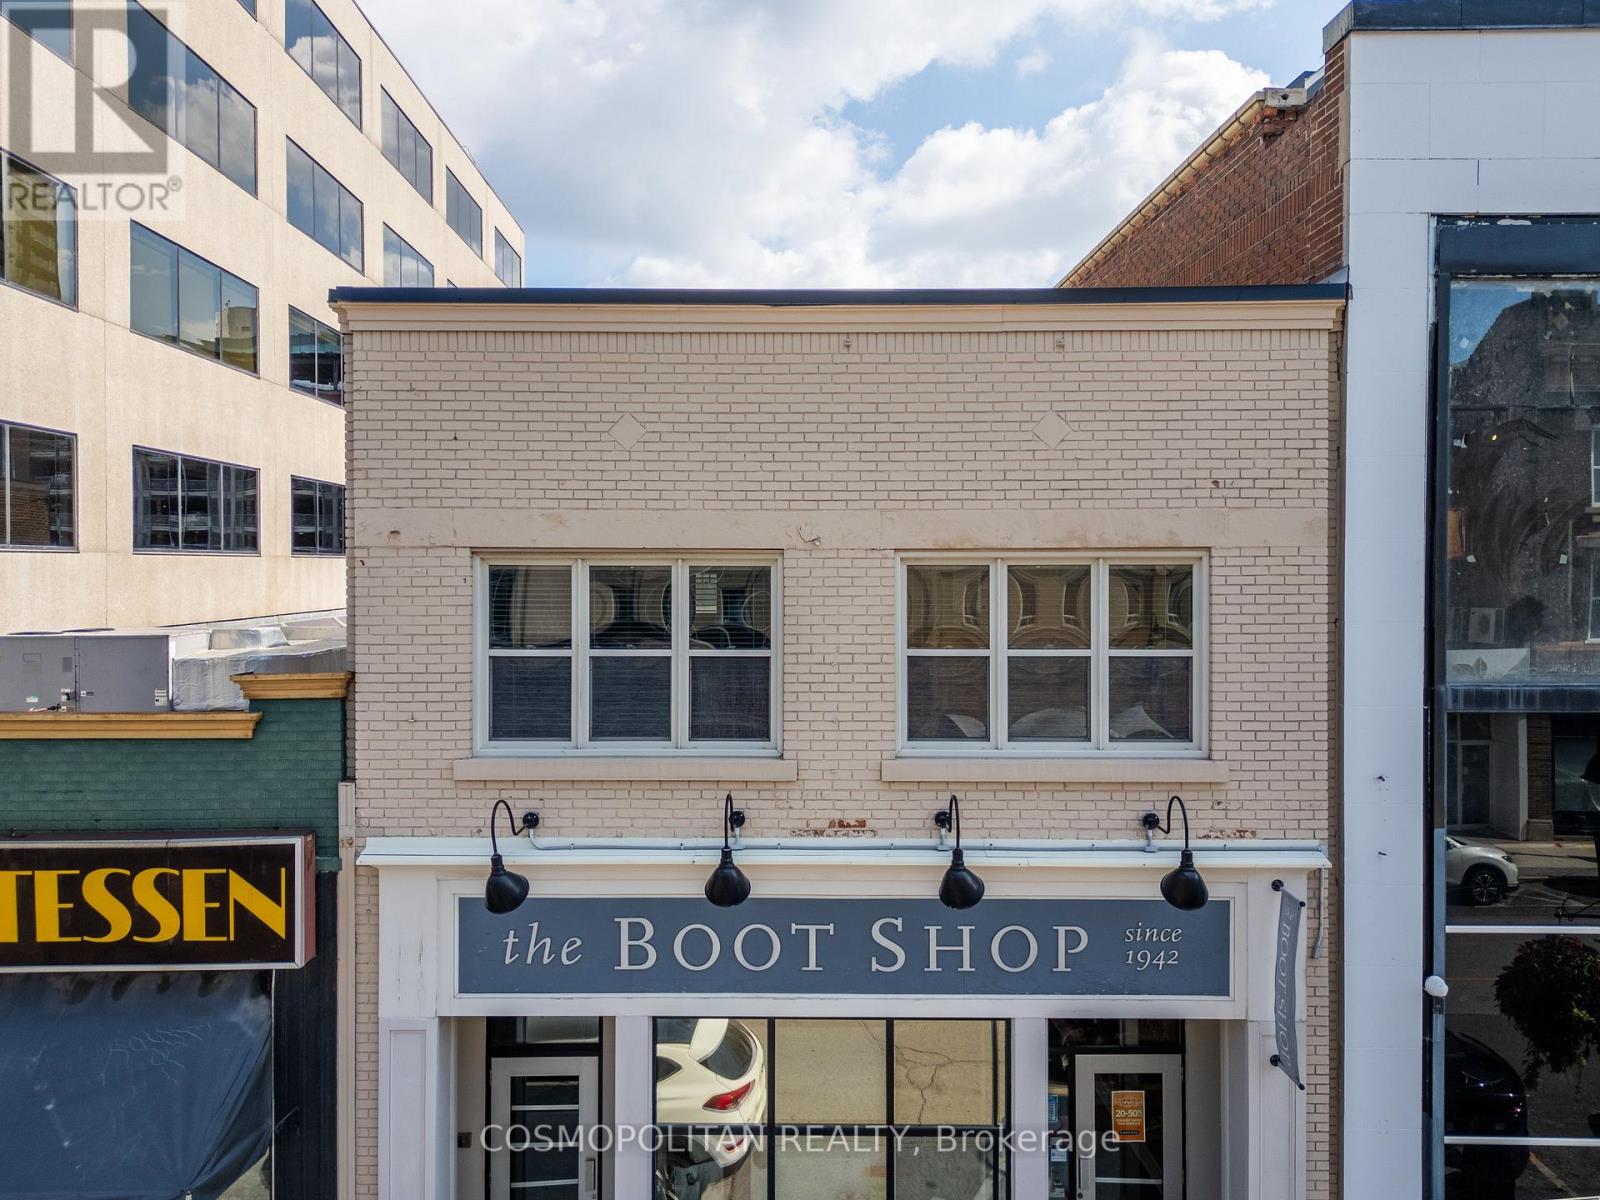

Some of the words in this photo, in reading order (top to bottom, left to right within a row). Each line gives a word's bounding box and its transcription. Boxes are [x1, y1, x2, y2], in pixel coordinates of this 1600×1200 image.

[0, 867, 286, 943] TESSEN
[503, 922, 583, 965] the
[614, 917, 834, 971] BOOT
[871, 917, 1089, 973] SHOP
[1124, 922, 1183, 942] since
[1125, 949, 1180, 971] 1942
